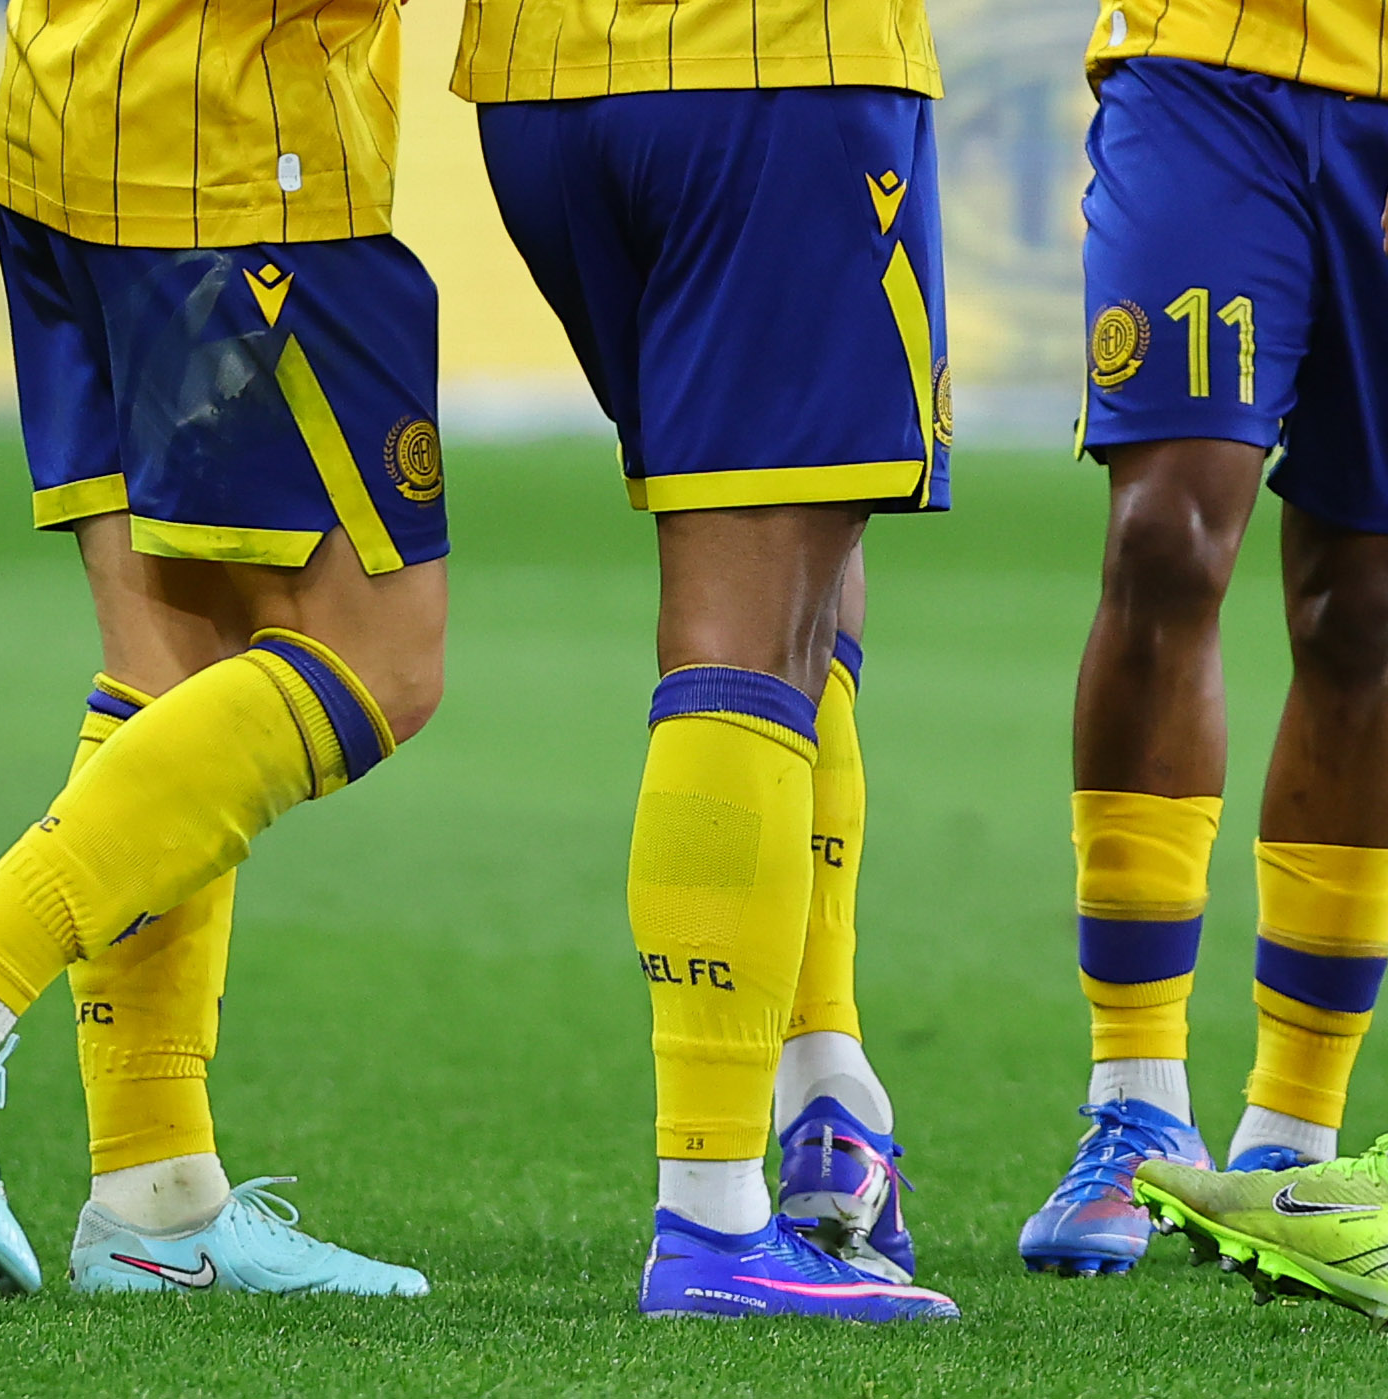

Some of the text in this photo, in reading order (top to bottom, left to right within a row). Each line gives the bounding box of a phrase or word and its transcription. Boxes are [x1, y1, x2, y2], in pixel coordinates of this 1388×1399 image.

[1163, 287, 1257, 406] 11
[688, 958, 737, 992] FC
[80, 1001, 115, 1025] FC
[685, 1137, 705, 1151] 23
[683, 1287, 768, 1309] AIR ZOOM
